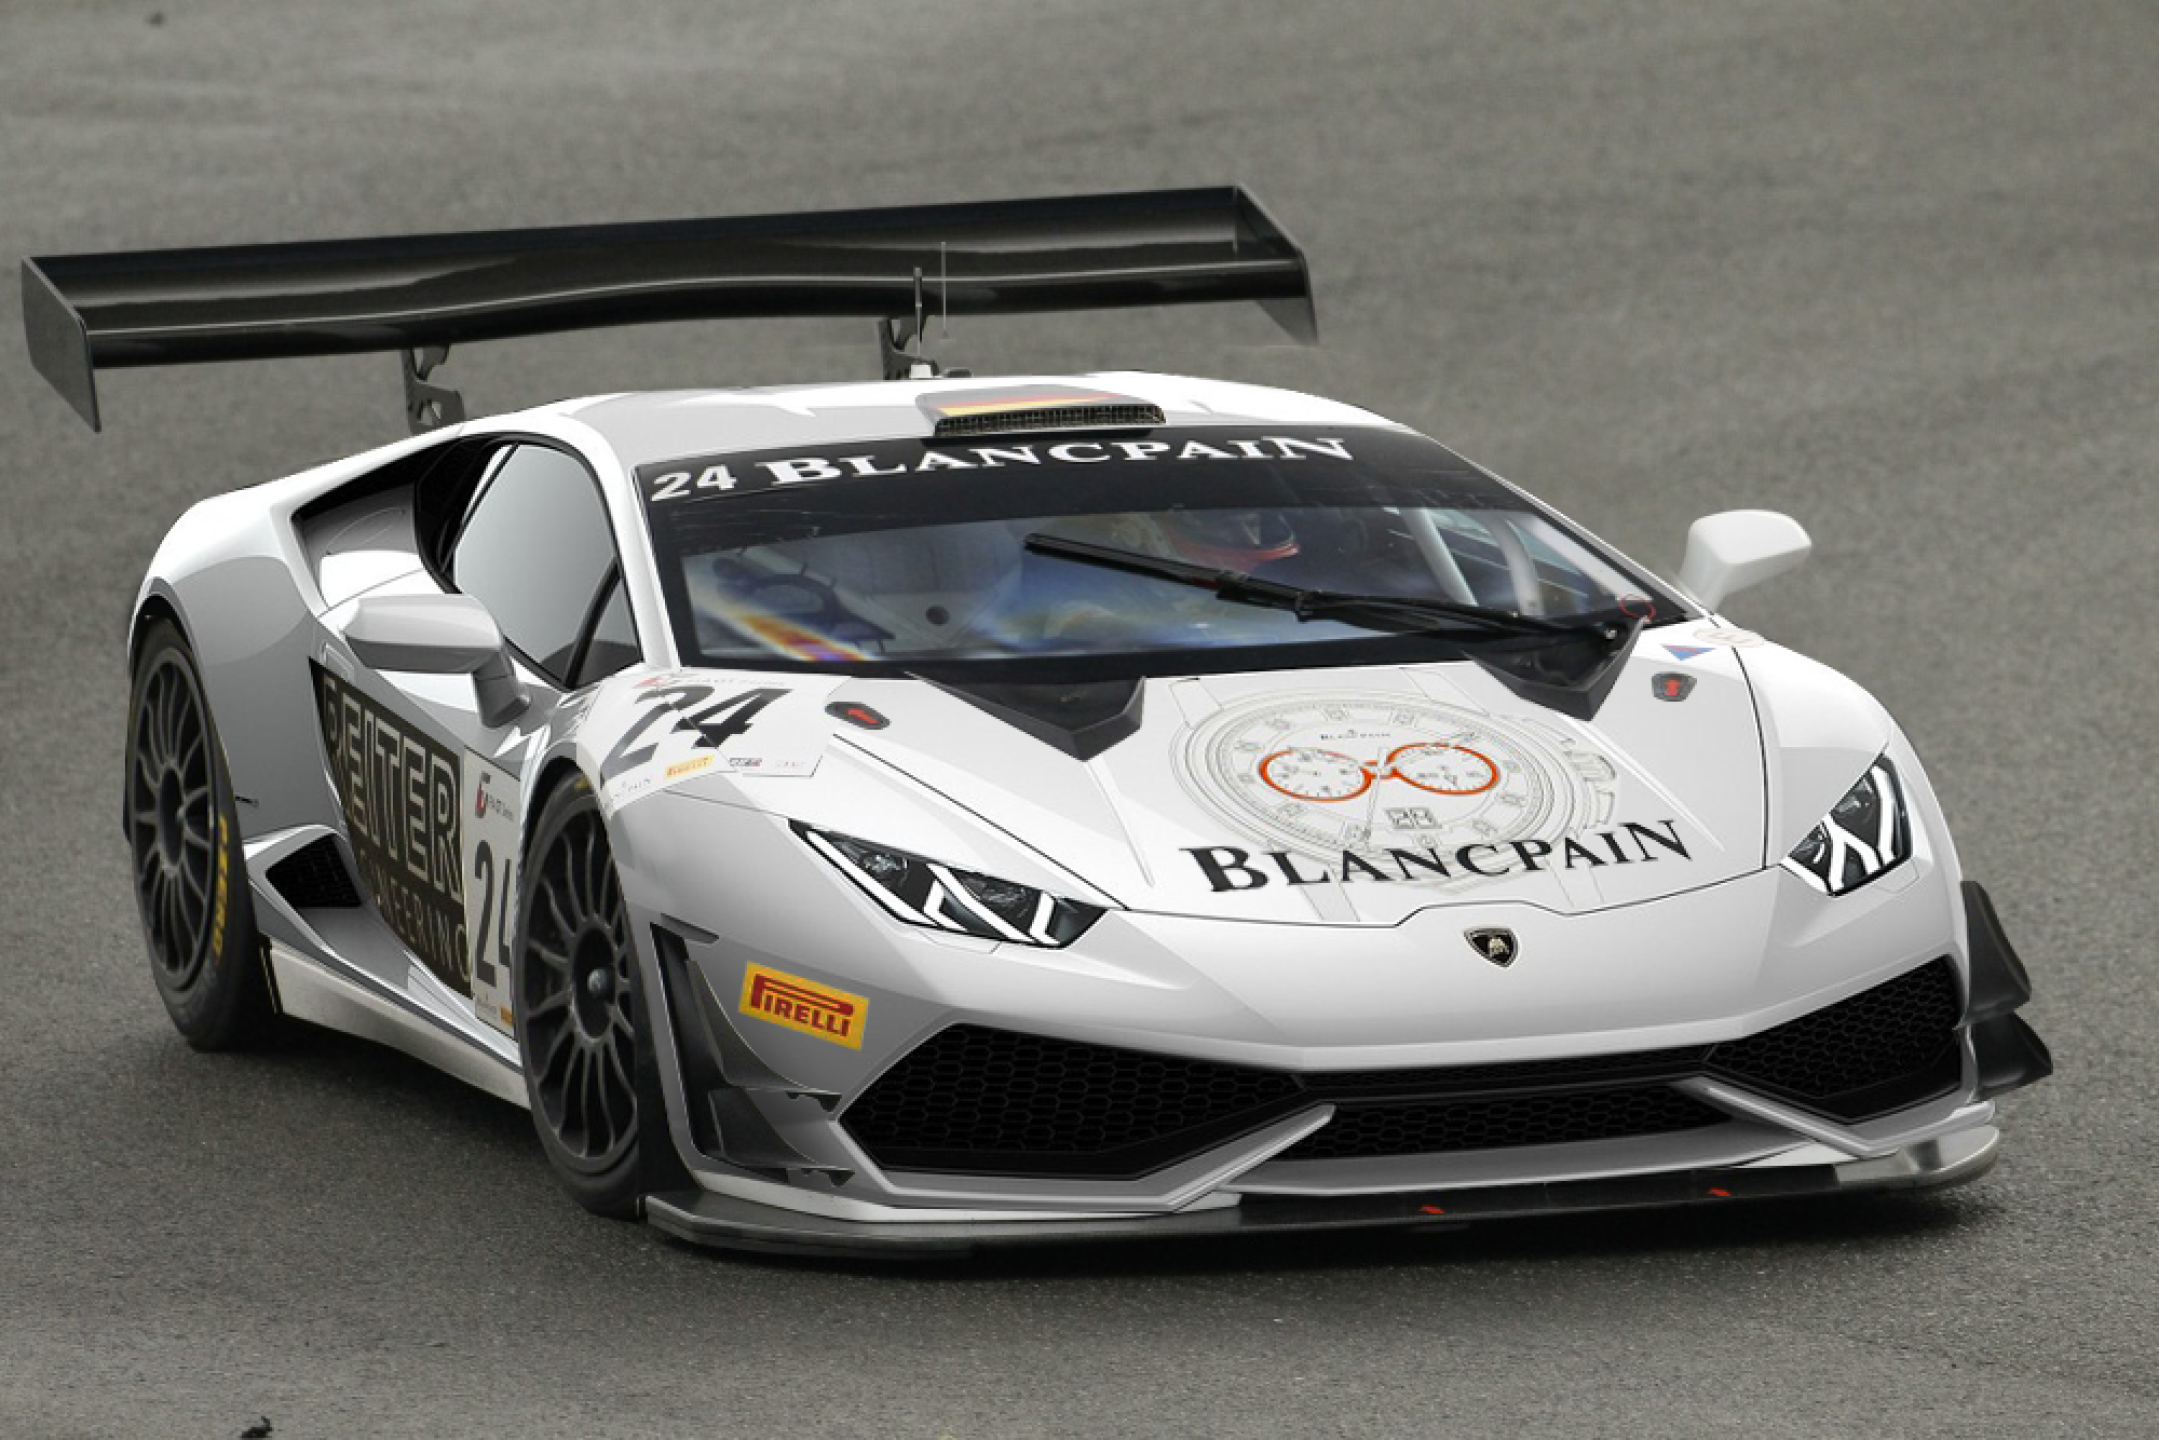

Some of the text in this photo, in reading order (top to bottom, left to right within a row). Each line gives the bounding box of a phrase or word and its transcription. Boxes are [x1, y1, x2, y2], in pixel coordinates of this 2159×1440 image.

[651, 434, 1353, 501] 24 BLANCPAIN
[599, 685, 793, 791] 24
[1182, 819, 1692, 893] BLANCPAIN
[751, 973, 855, 1037] PIRELLI
